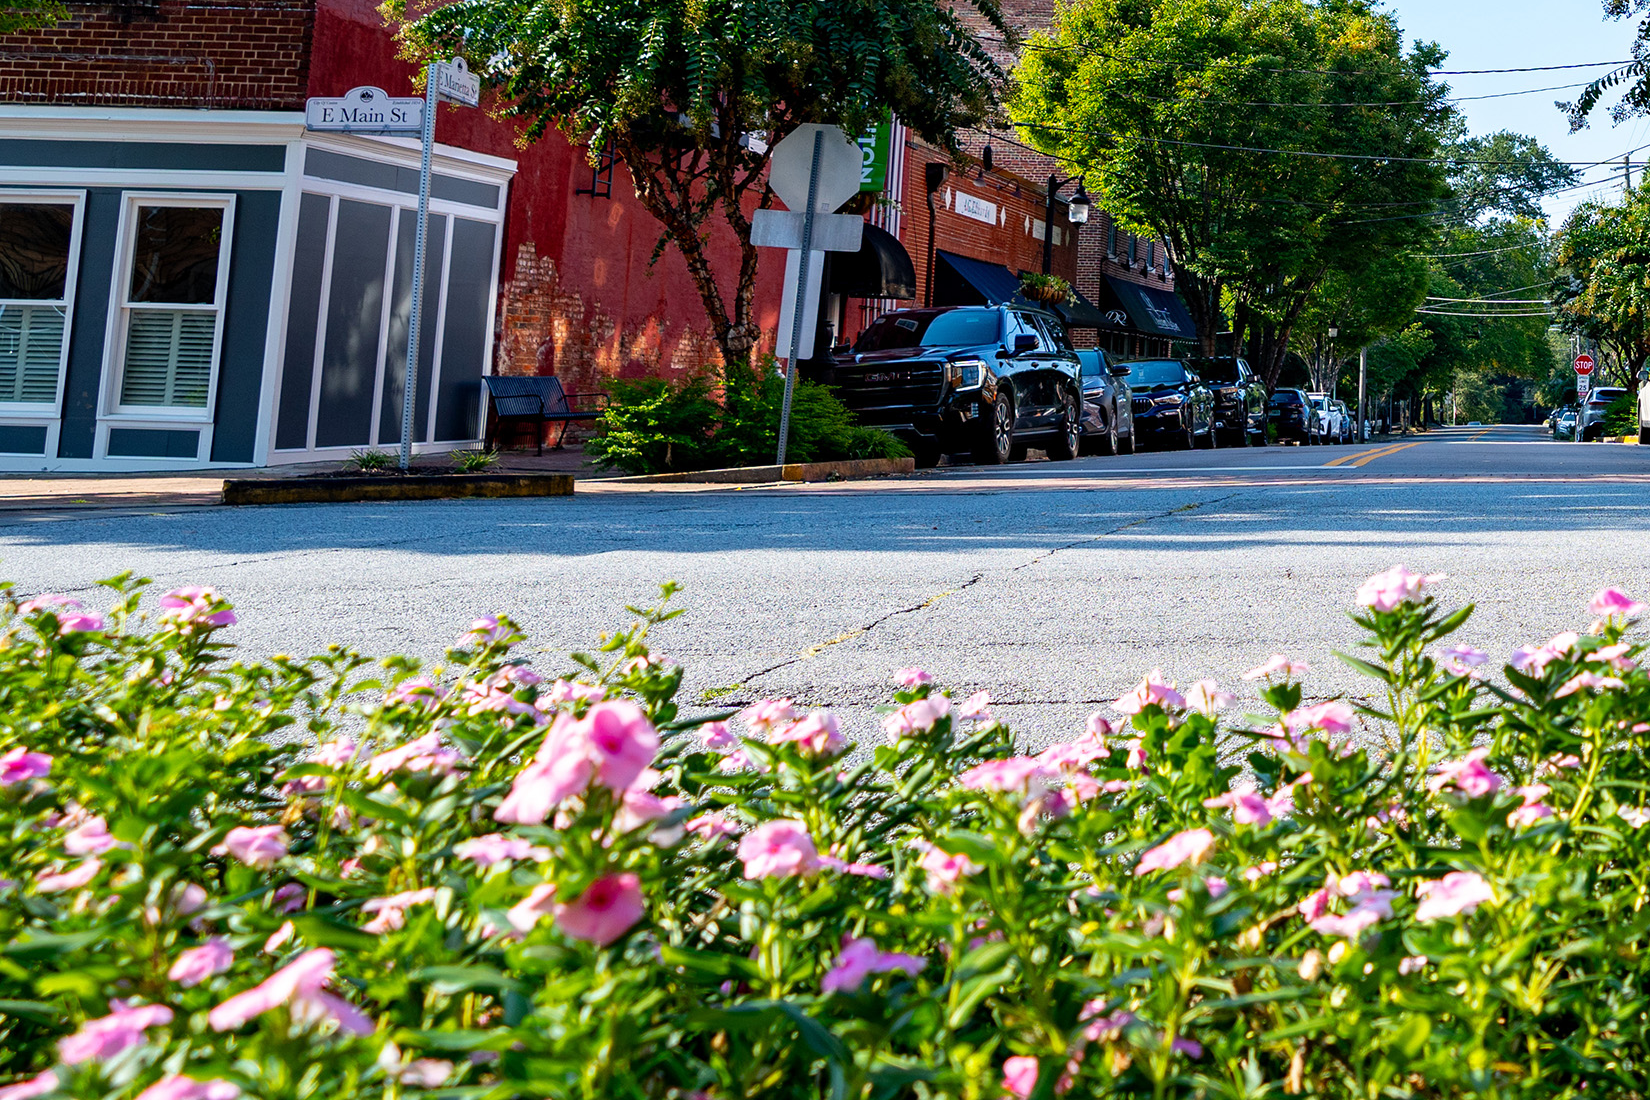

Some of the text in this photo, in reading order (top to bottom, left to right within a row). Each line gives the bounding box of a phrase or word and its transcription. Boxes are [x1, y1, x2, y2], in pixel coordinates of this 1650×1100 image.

[322, 107, 408, 123] E Main St
[1575, 361, 1593, 369] STOP
[864, 371, 911, 382] GMC
